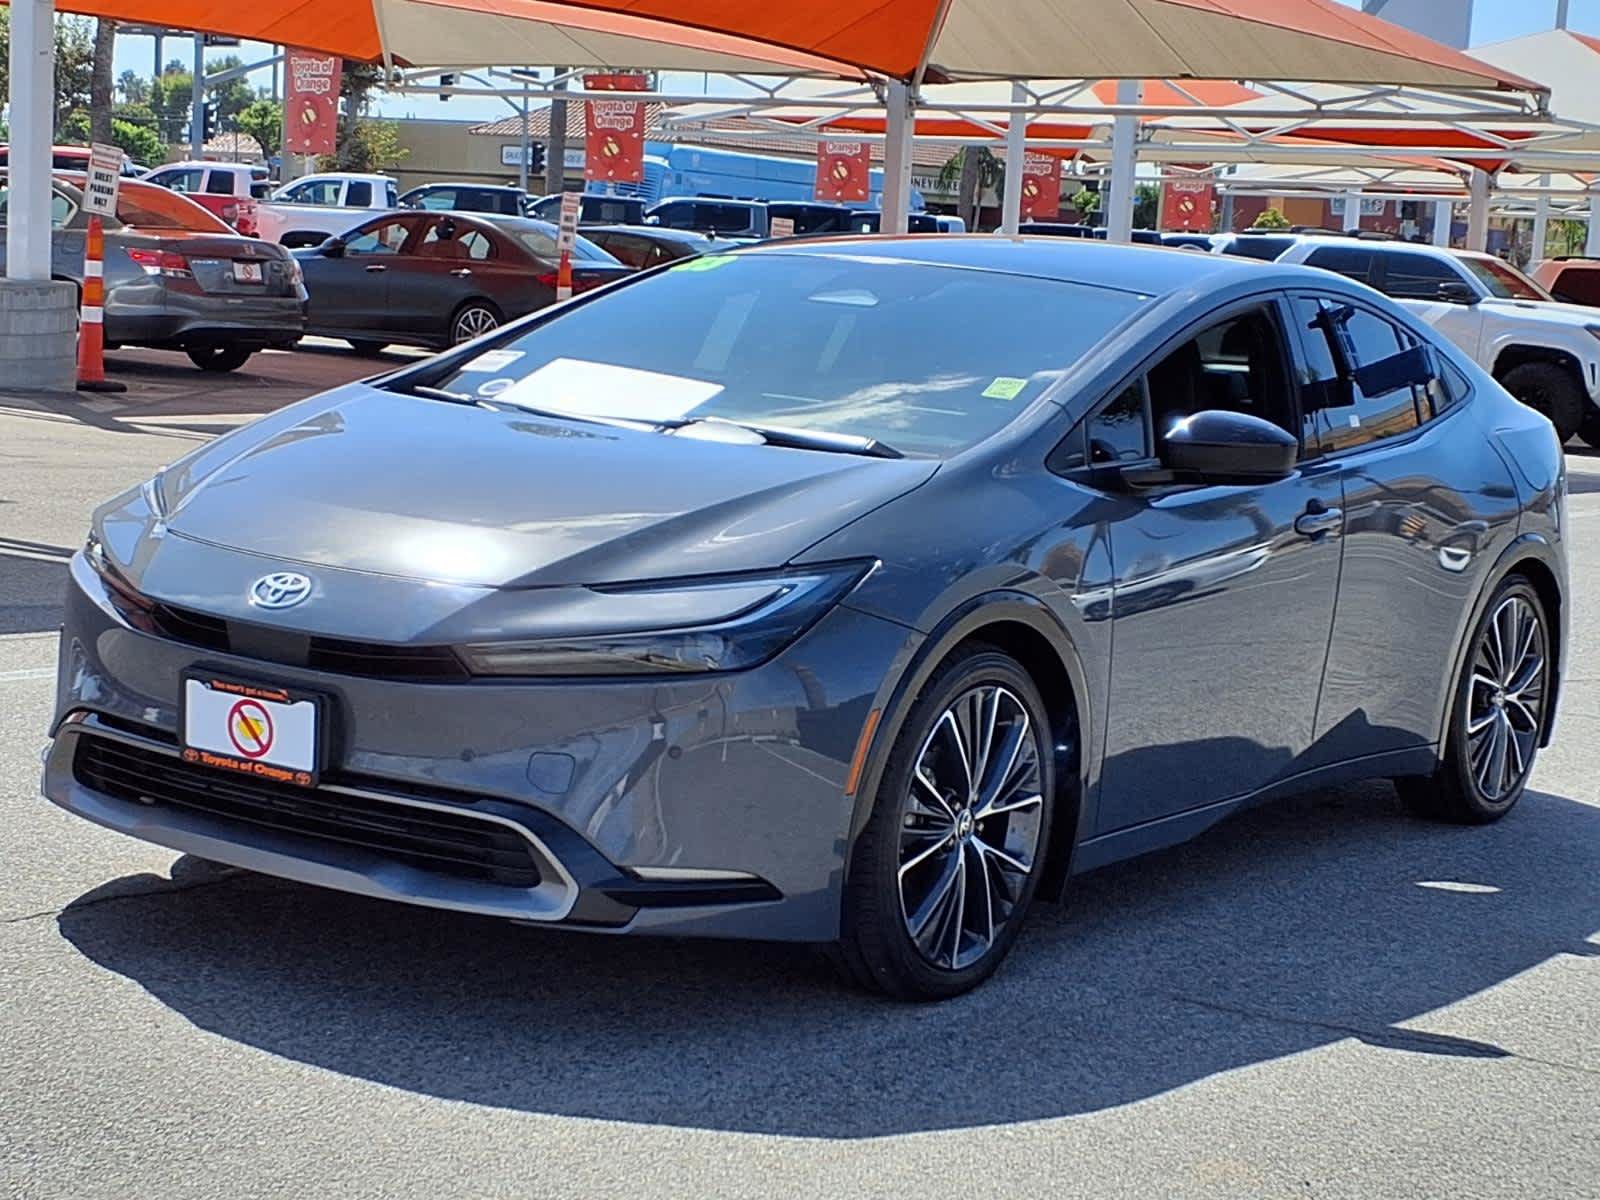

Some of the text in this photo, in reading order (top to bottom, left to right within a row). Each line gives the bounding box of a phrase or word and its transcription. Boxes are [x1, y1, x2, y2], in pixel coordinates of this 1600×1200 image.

[291, 57, 320, 77] Toyota
[295, 77, 331, 94] Orange
[594, 114, 634, 131] Orange
[1023, 163, 1052, 176] range
[200, 752, 293, 781] Toyota of Orange
